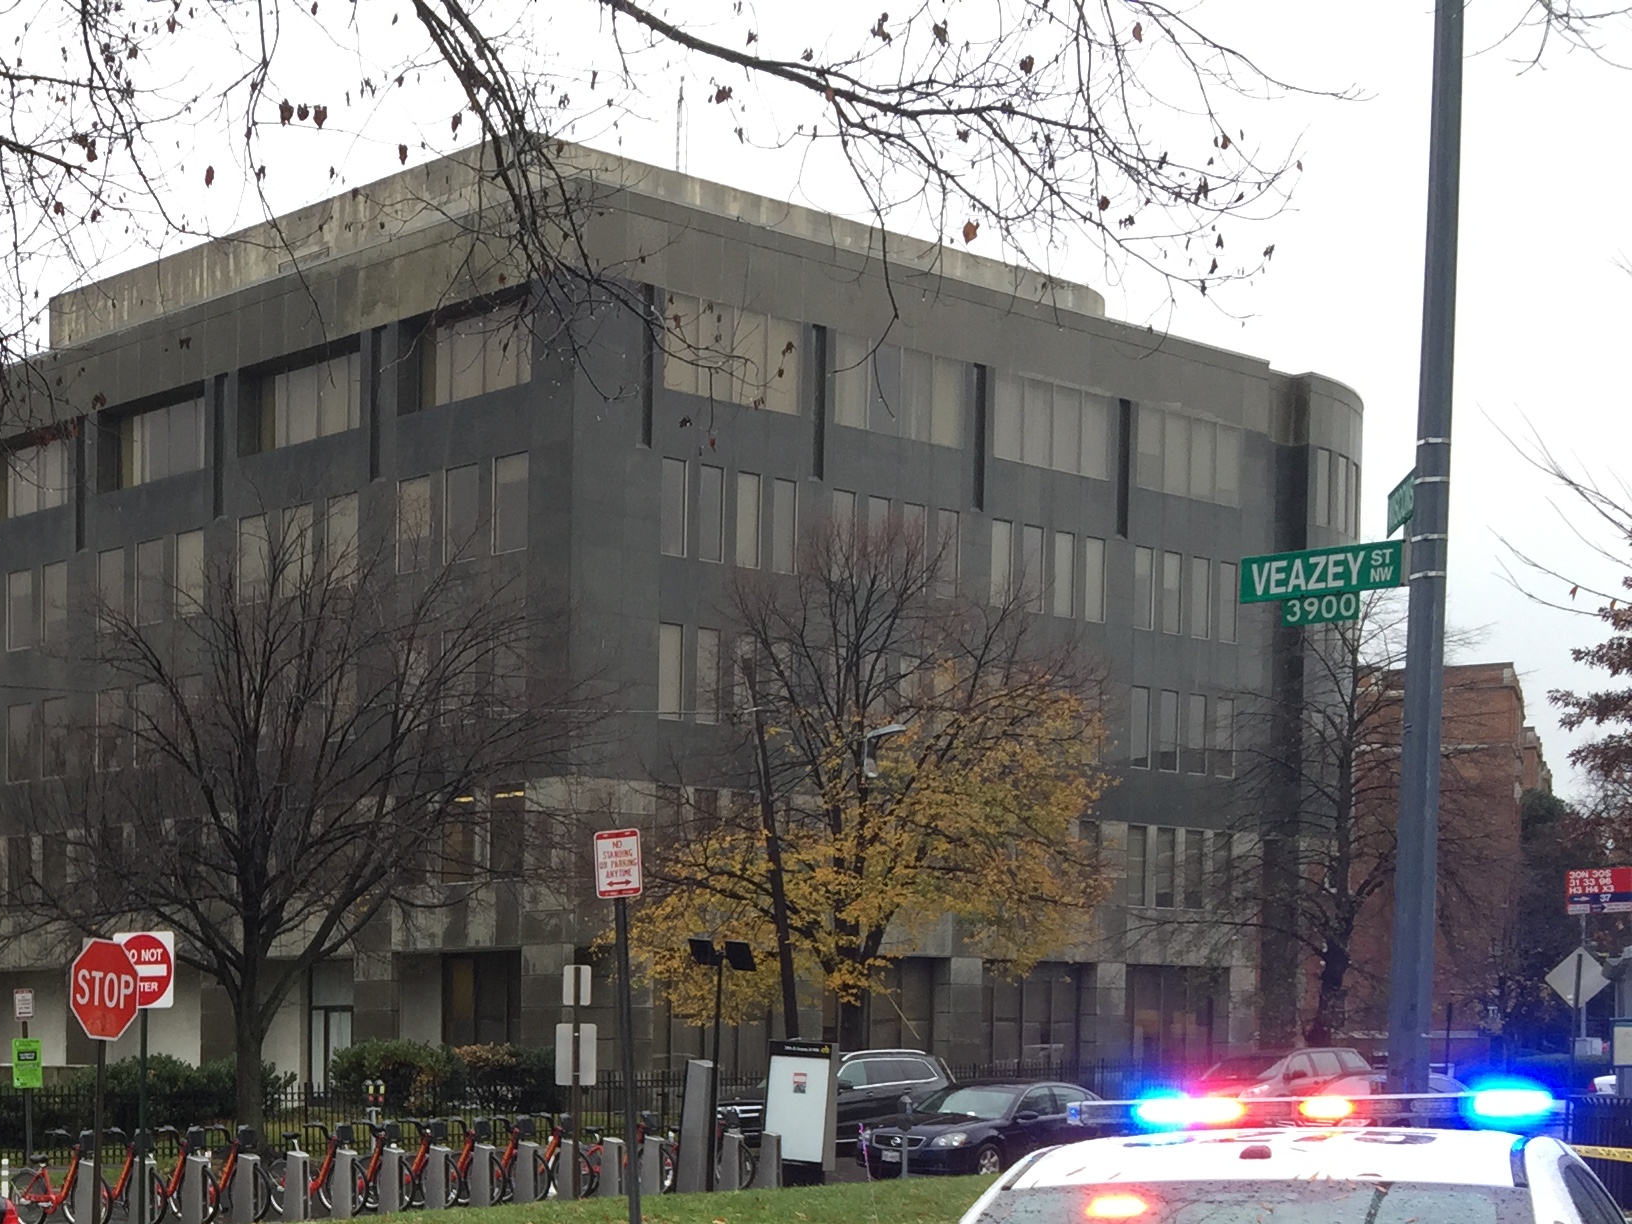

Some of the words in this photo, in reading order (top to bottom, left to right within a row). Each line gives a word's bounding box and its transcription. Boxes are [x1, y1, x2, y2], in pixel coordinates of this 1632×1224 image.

[1251, 551, 1366, 596] VEAZEY
[1370, 549, 1394, 566] ST
[1370, 565, 1394, 583] NW
[1286, 593, 1356, 622] 3900
[612, 840, 622, 849] NO
[603, 848, 633, 859] STANDING
[611, 858, 638, 868] PARKING
[605, 868, 632, 878] ANYTIME
[1569, 870, 1589, 879] 30N
[1569, 879, 1580, 887] 31
[1583, 878, 1596, 886] 33
[1569, 886, 1583, 894] H3
[1599, 894, 1612, 902] 37
[140, 948, 164, 962] NOT
[75, 968, 135, 1010] STOP
